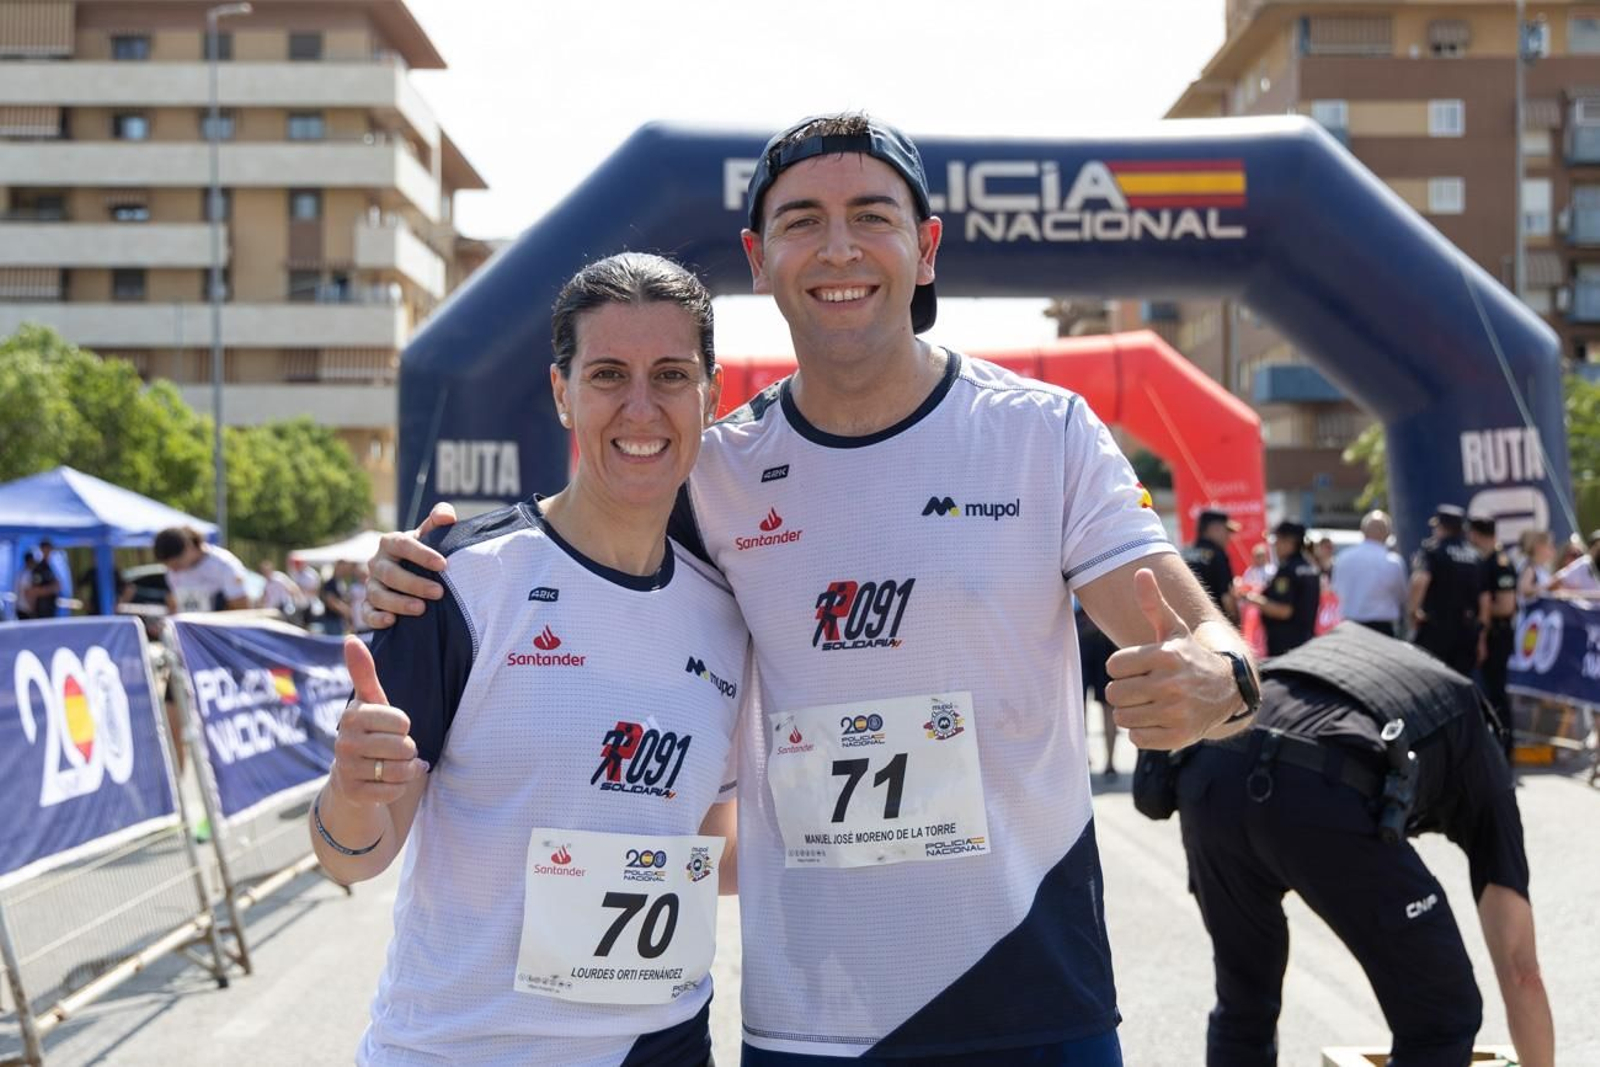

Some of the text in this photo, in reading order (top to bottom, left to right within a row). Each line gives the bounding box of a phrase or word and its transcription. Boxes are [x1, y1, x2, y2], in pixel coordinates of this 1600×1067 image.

[965, 209, 1247, 241] NACIONAL
[1460, 427, 1545, 486] RUTA
[436, 440, 520, 495] RUTA
[965, 498, 1020, 521] mupol
[735, 529, 802, 550] Santander
[822, 638, 895, 651] SOLIDARIA
[507, 652, 586, 667] Santander
[710, 670, 737, 699] mupol
[841, 714, 883, 735] 200
[777, 743, 814, 755] Santander
[600, 782, 671, 799] SOLIDARIA
[831, 753, 908, 823] 71
[804, 834, 831, 845] MANUEL
[855, 830, 894, 843] MORENO
[896, 828, 908, 840] DE
[911, 827, 923, 838] LA
[925, 823, 956, 837] TORRE
[626, 849, 667, 868] 200
[926, 844, 986, 857] NACIONAL
[534, 864, 586, 877] Santander
[1405, 894, 1438, 919] CNP
[593, 891, 680, 959] 70
[571, 966, 683, 980] LOURDES ORTI FERNÁNDEZ
